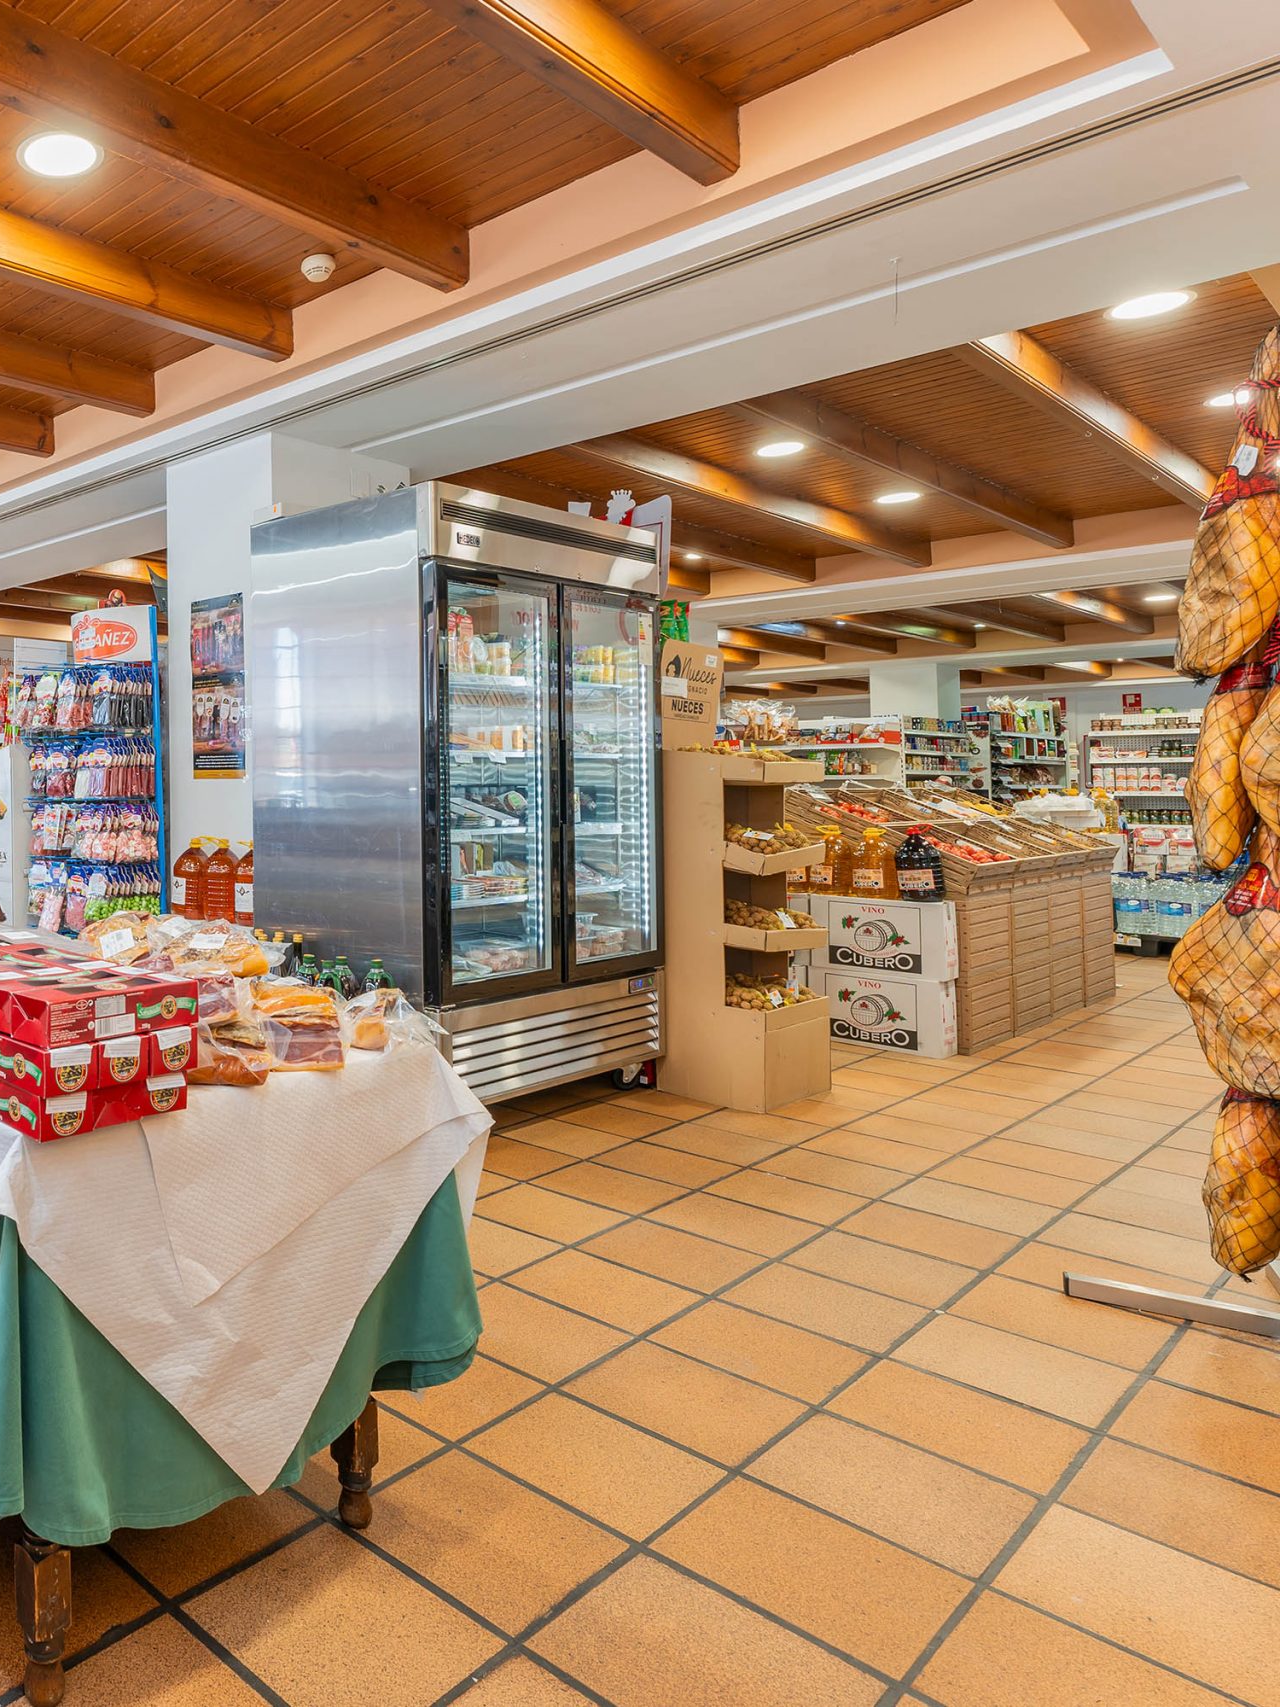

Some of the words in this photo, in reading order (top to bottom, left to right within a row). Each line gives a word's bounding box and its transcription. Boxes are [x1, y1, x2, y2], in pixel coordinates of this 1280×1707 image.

[681, 656, 717, 685] Nueces
[671, 698, 704, 715] NUECES
[861, 906, 885, 914] VINO
[836, 947, 914, 970] CUBERO
[858, 980, 881, 989] VINO
[833, 1020, 910, 1046] CUBERO
